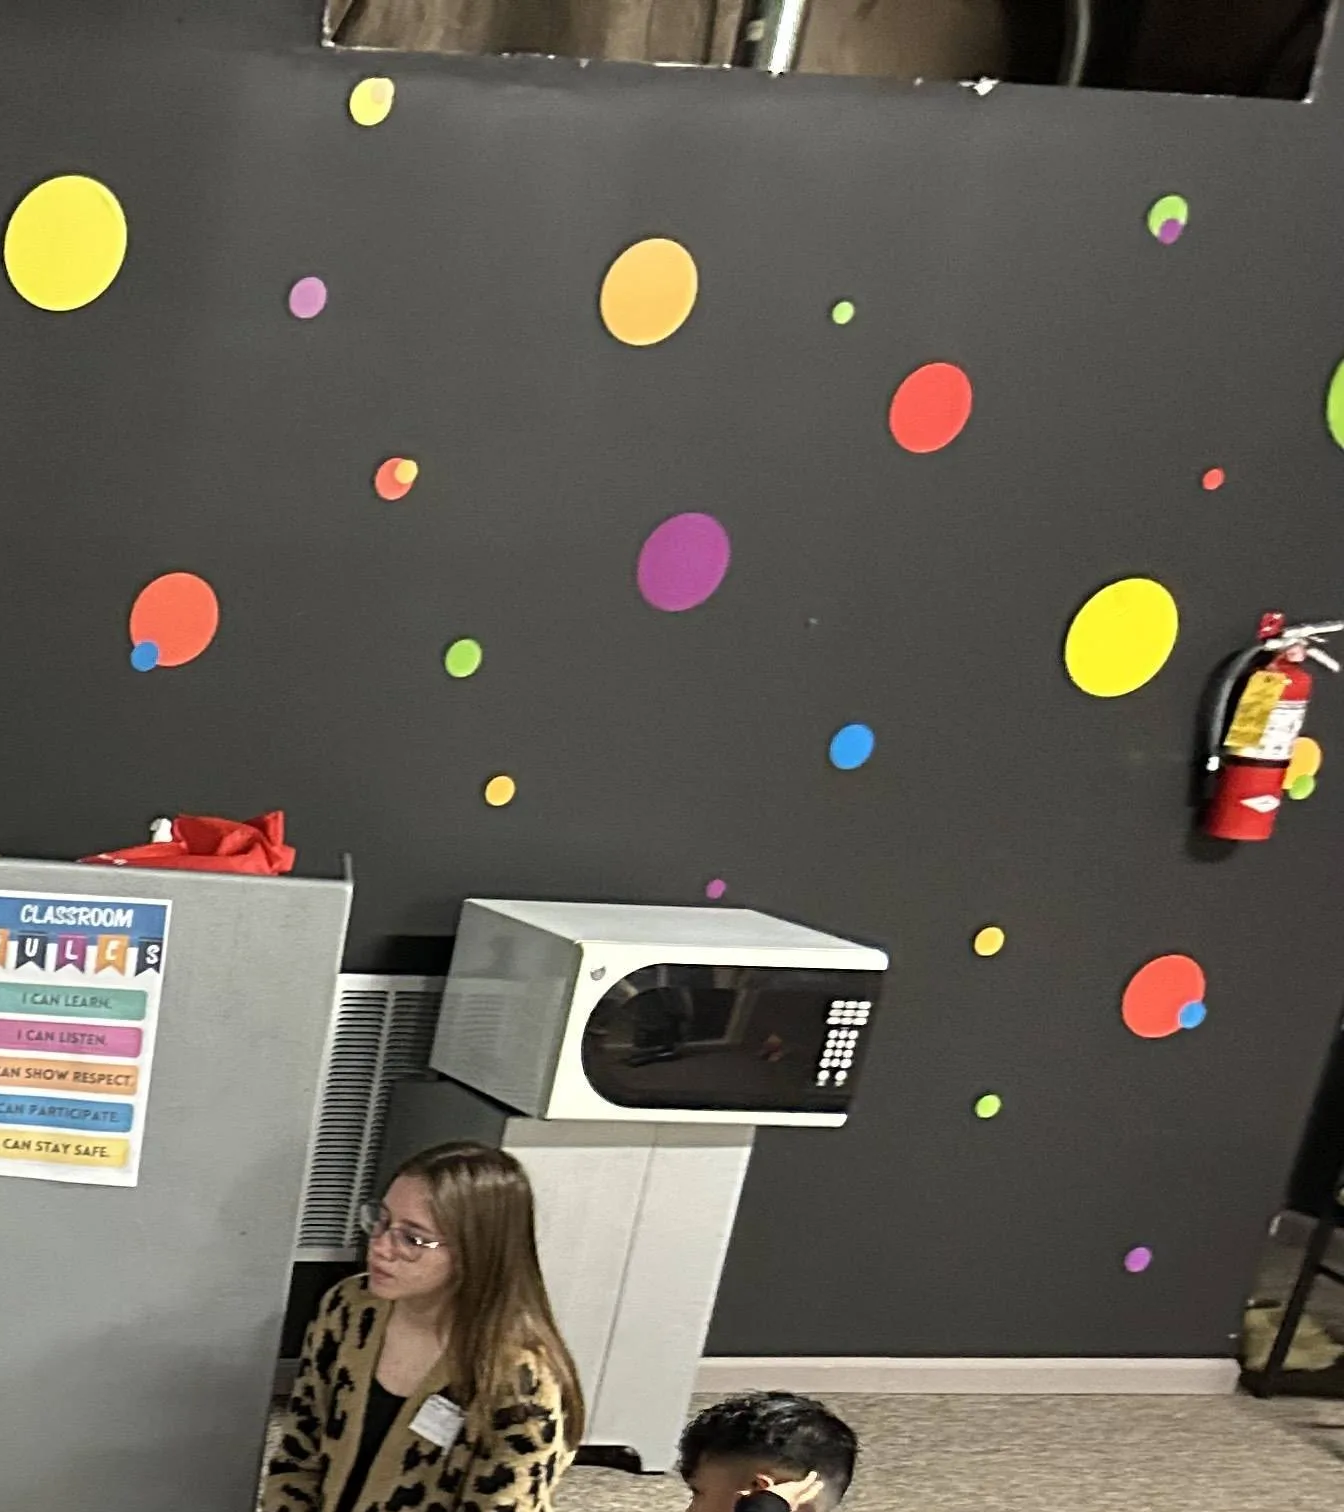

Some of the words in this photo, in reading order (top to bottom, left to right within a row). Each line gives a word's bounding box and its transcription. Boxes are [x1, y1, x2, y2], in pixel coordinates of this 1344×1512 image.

[20, 904, 135, 928] CLASSROOM
[22, 992, 27, 1004] I
[31, 993, 60, 1006] CAN
[17, 1030, 22, 1040] I
[26, 1029, 54, 1042] CAN
[25, 1068, 69, 1080] SHOW
[2, 1138, 31, 1150] CAN
[35, 1141, 72, 1154] STAY
[74, 1144, 111, 1158] SAFE.
